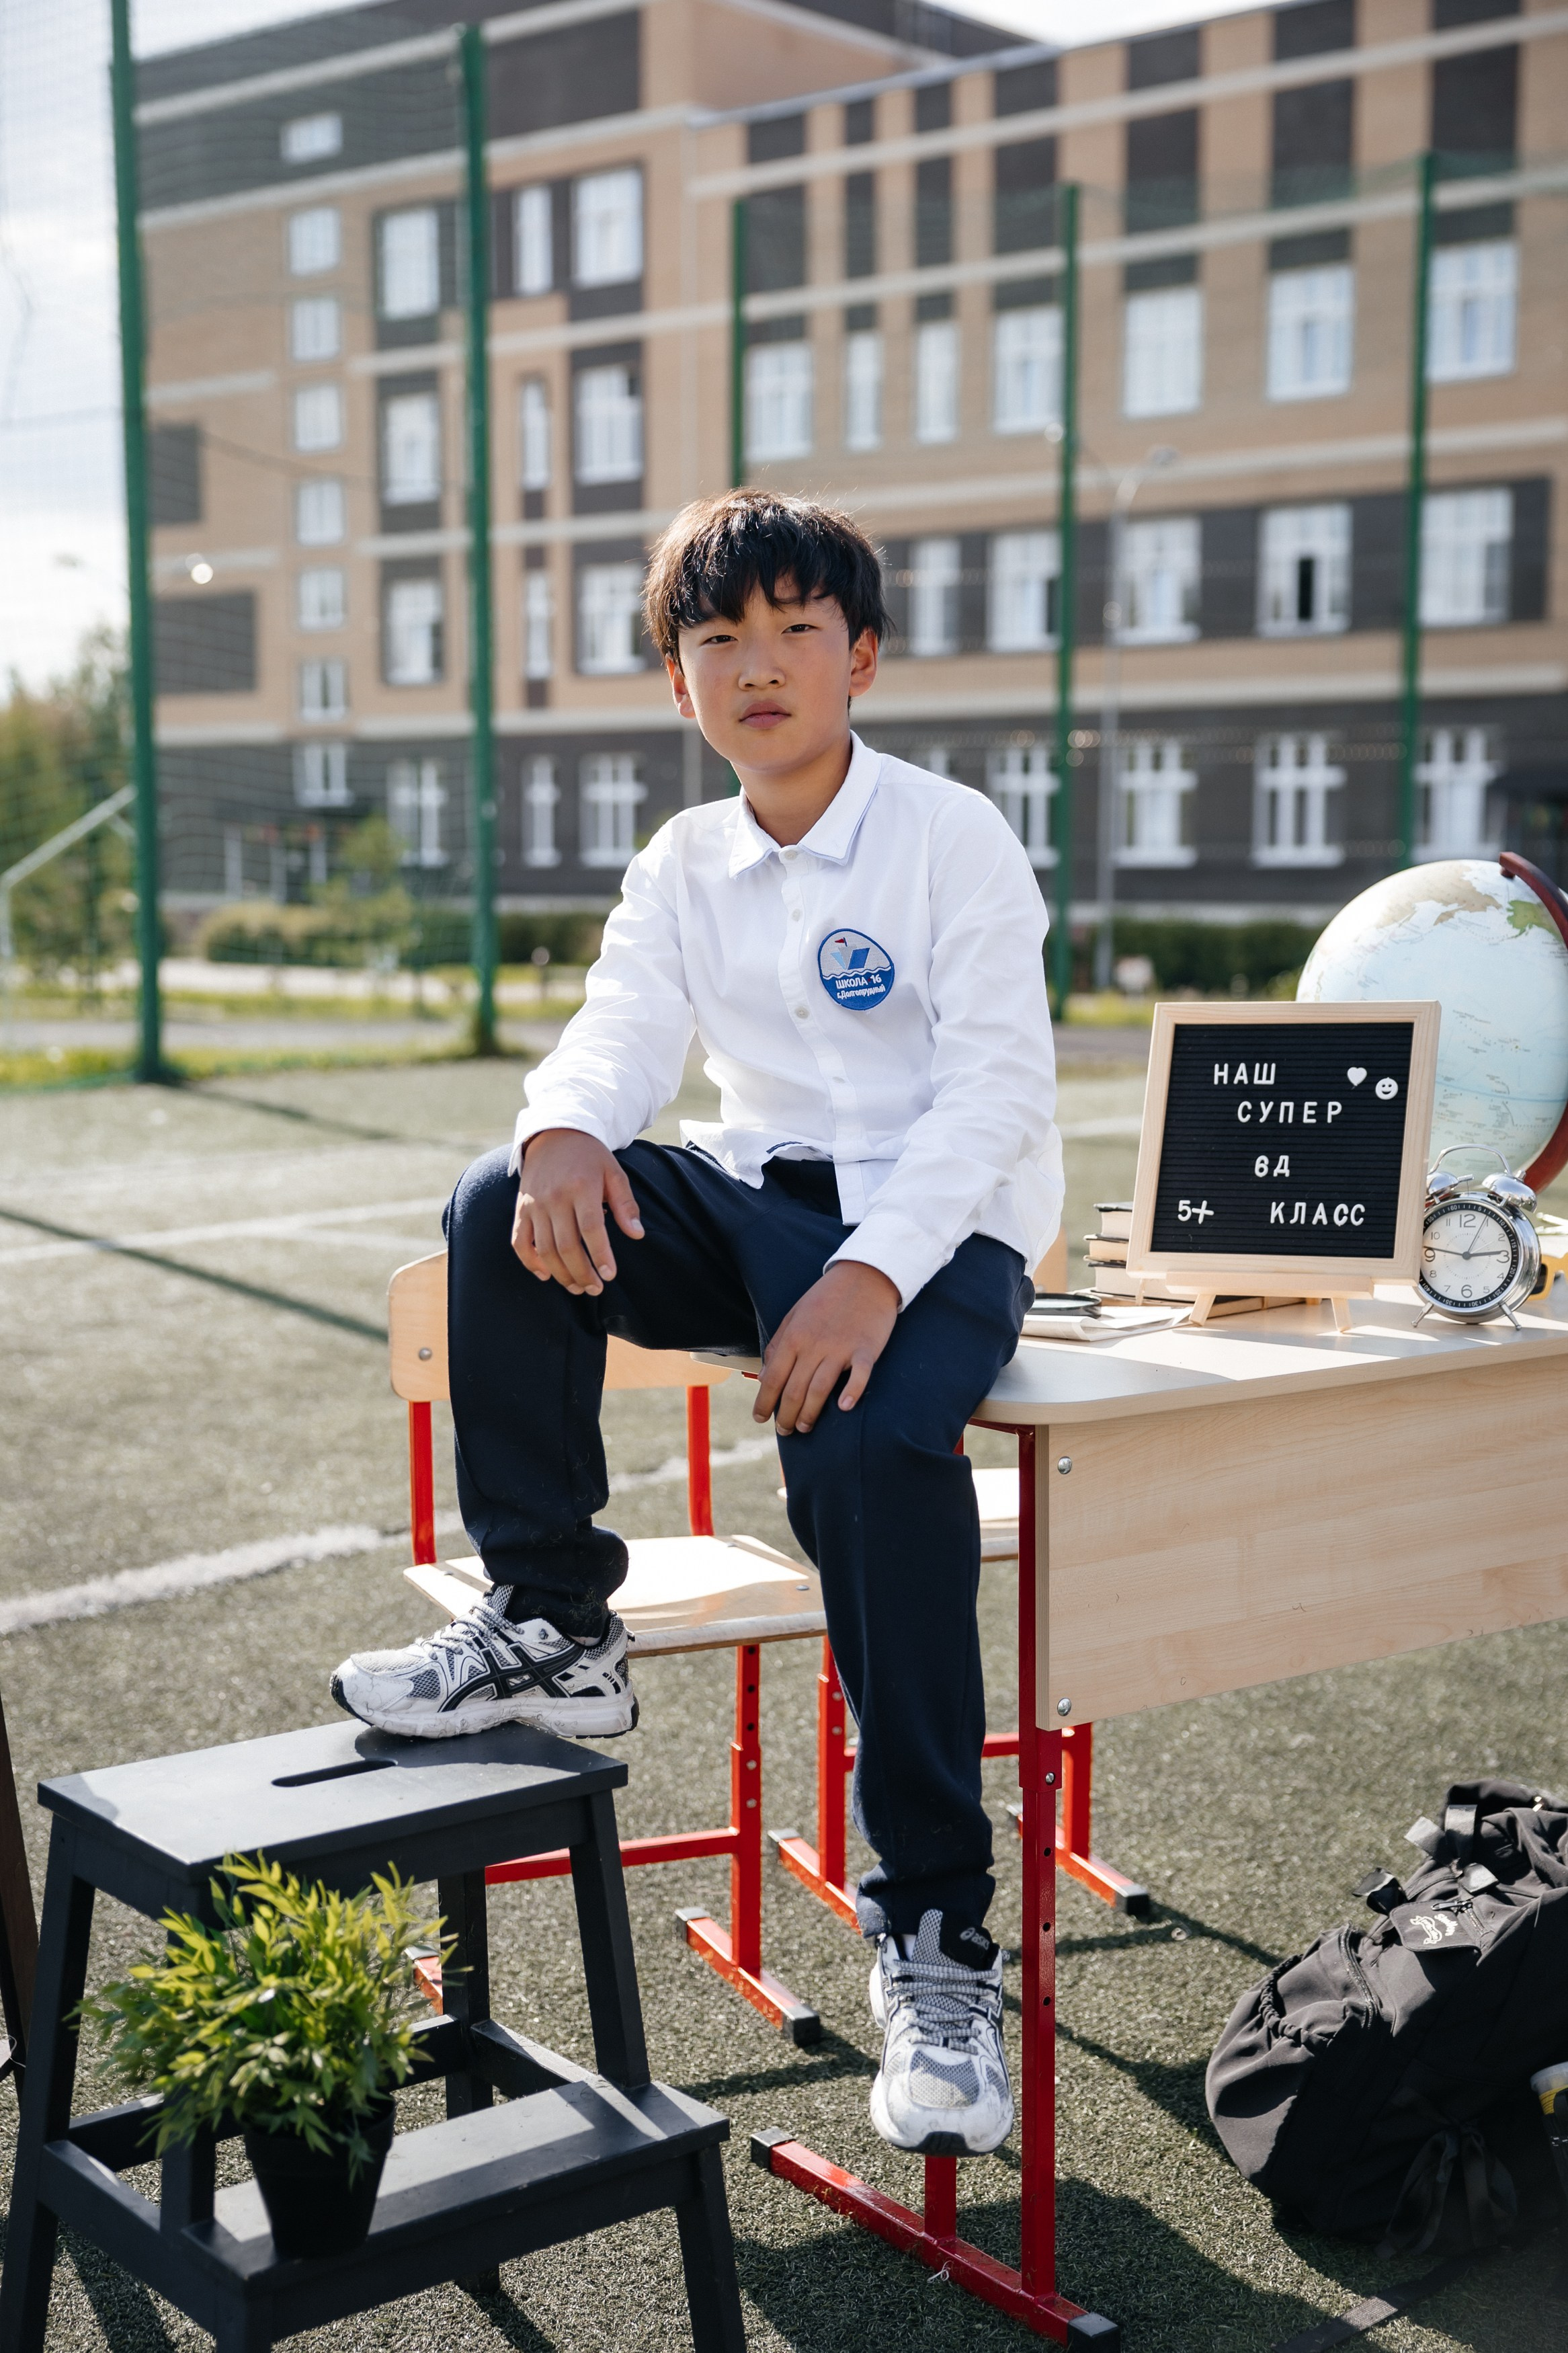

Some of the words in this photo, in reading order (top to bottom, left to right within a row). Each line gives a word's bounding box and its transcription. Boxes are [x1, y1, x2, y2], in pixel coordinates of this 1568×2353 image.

[835, 977, 868, 989] ШКОЛА
[870, 975, 882, 984] 16
[1214, 1062, 1276, 1084] НАШ
[1237, 1101, 1342, 1123] СУПЕР
[1178, 1199, 1214, 1224] 5+
[1270, 1201, 1365, 1226] КЛАСС
[1446, 1218, 1450, 1226] 11
[1460, 1214, 1476, 1228] 12
[1498, 1233, 1505, 1241] 2
[1425, 1248, 1435, 1262] 9
[1497, 1250, 1510, 1263] 3
[1461, 1285, 1473, 1298] 6
